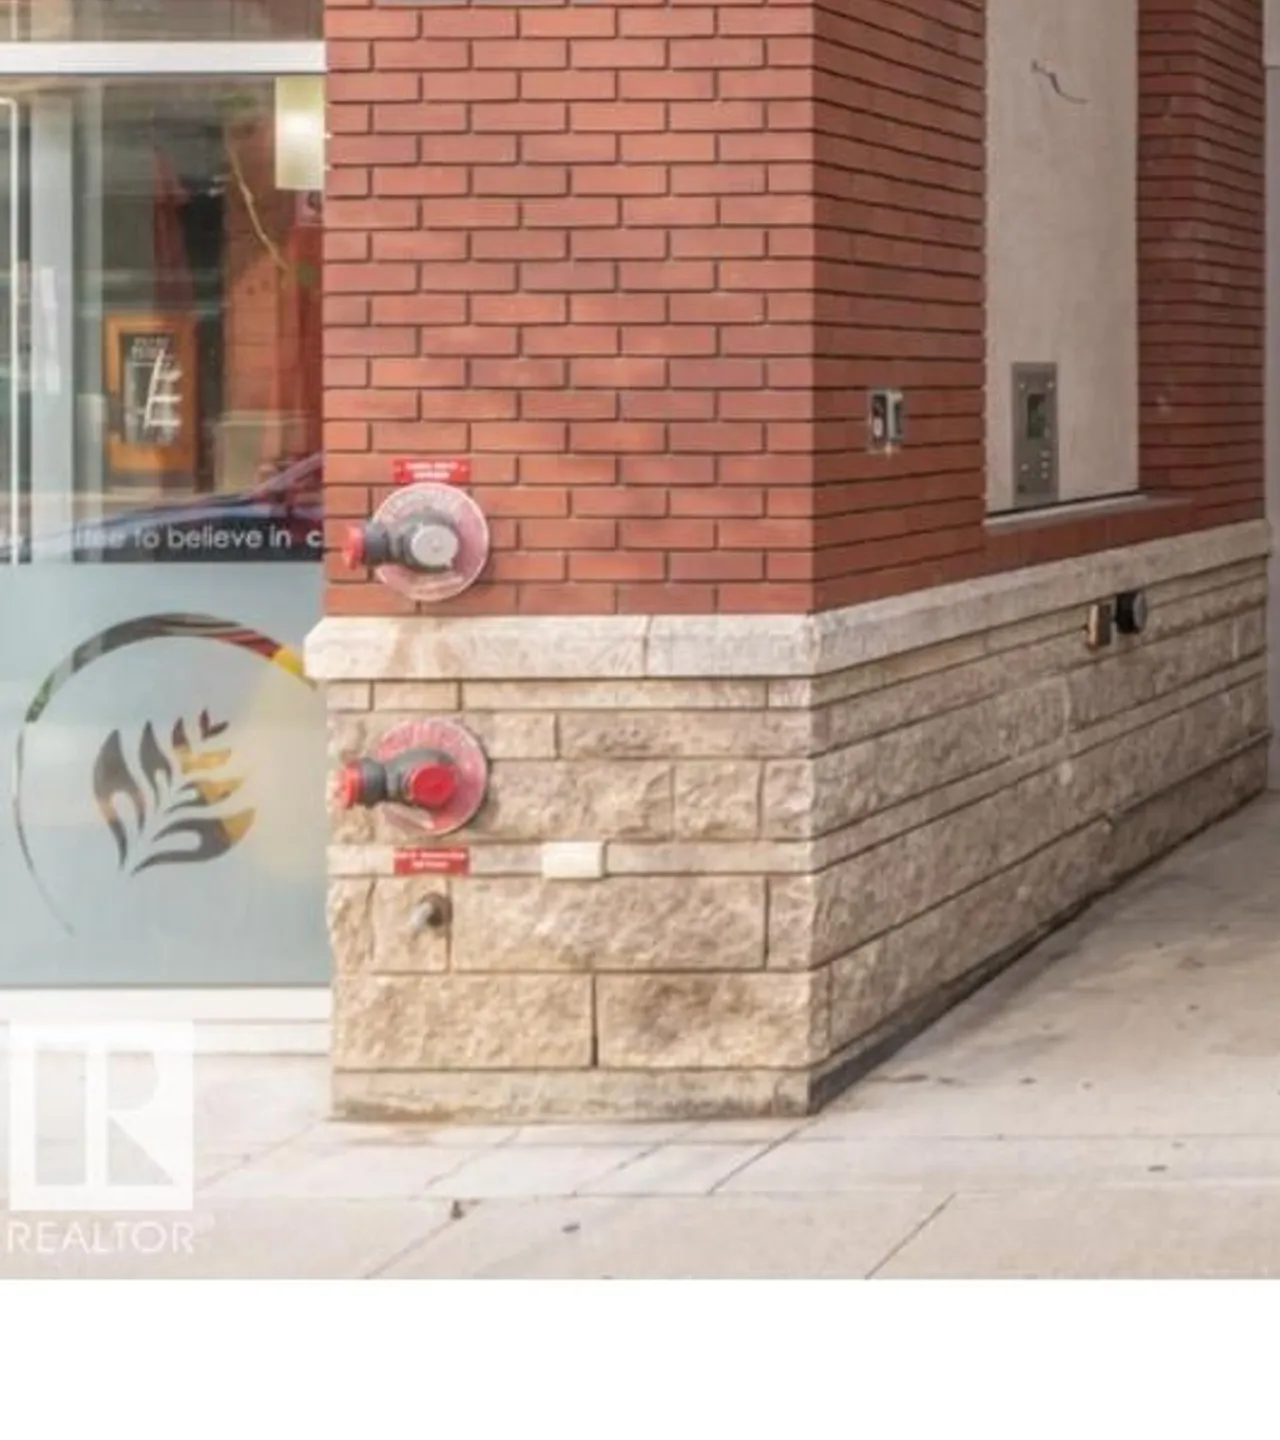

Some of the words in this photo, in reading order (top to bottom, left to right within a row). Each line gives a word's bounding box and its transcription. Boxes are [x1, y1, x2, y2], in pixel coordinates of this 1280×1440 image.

[134, 523, 160, 550] to
[167, 523, 262, 550] believe
[269, 524, 291, 549] in
